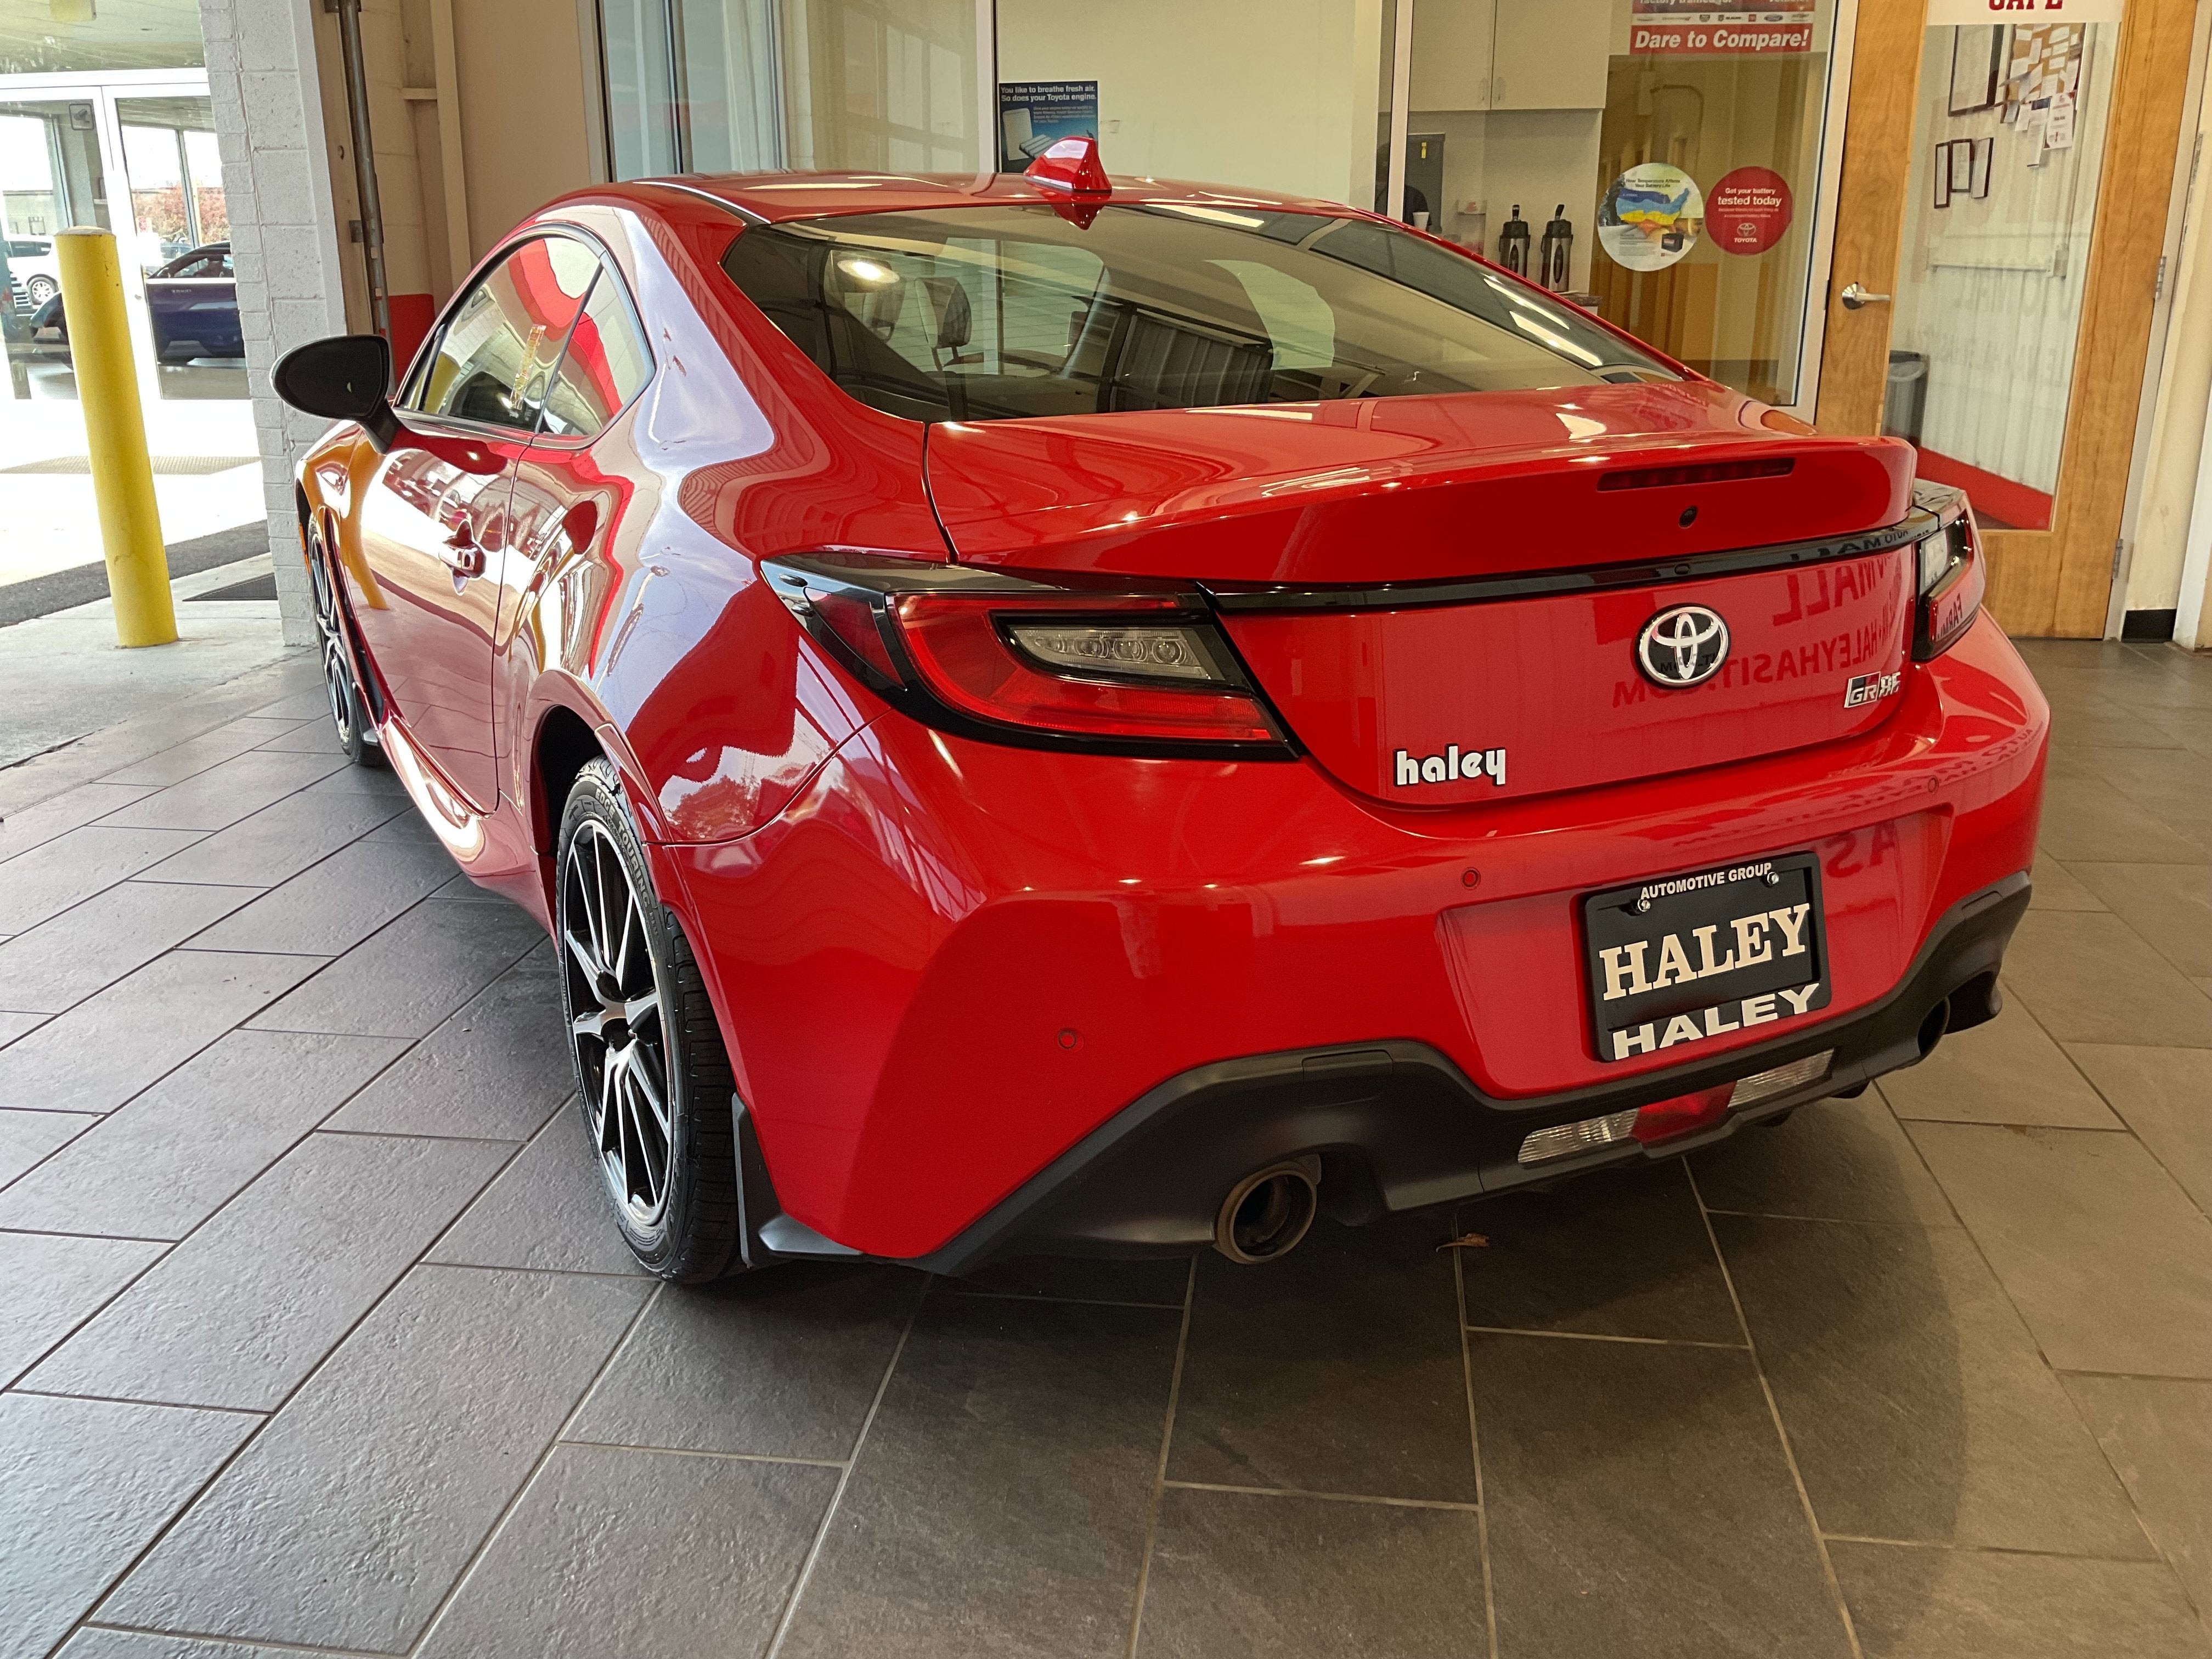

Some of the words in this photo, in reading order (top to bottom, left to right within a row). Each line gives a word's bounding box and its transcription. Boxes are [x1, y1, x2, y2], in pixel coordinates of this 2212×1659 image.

[1635, 30, 1681, 48] Dare
[1687, 31, 1707, 48] to
[1713, 29, 1810, 51] Compare!
[1047, 94, 1070, 102] Toyota
[1071, 93, 1097, 101] engine.
[1718, 196, 1751, 205] tested
[1753, 196, 1782, 207] today
[1395, 744, 1506, 786] haley
[595, 788, 616, 819] EDGE
[618, 820, 650, 907] TOURING
[1640, 872, 1725, 900] AUTOMOTIVE
[1728, 862, 1772, 882] GROUP
[1599, 902, 1810, 1001] HALEY
[1612, 983, 1820, 1060] HALEY
